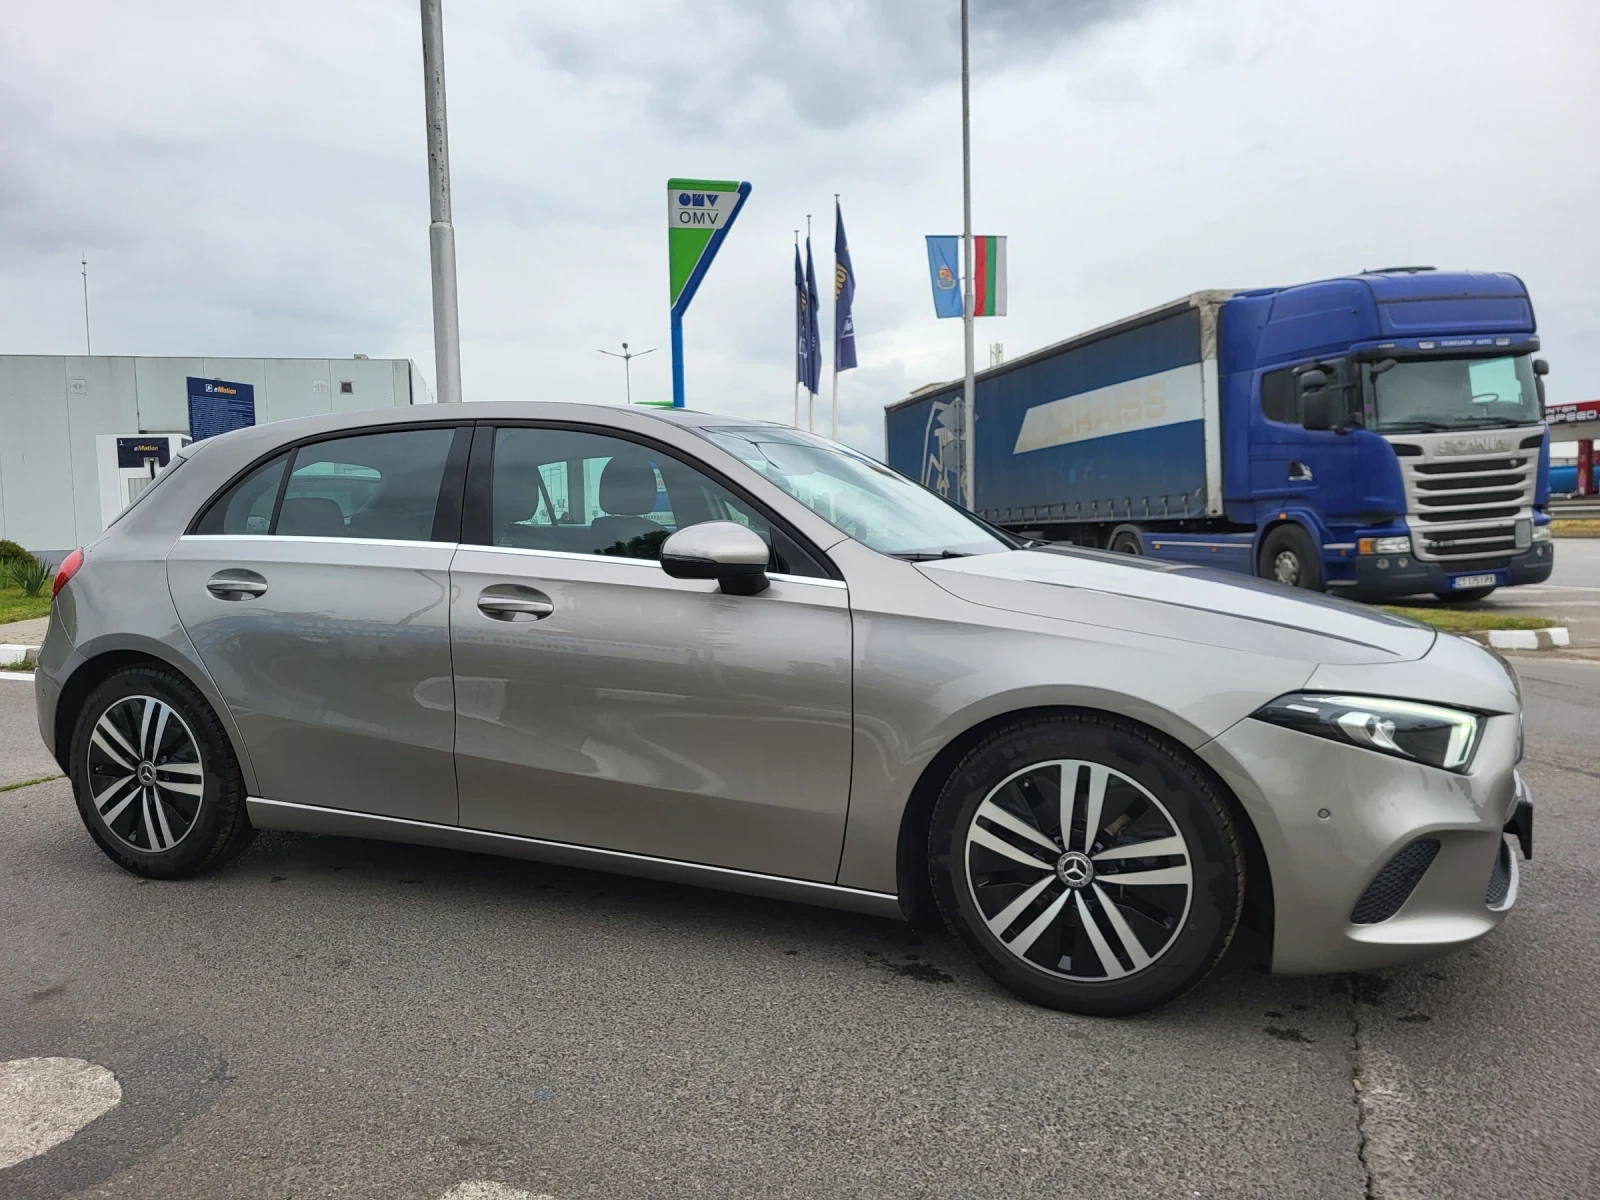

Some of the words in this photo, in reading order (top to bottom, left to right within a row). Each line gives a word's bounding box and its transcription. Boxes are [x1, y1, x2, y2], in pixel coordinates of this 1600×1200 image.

[679, 211, 719, 225] OMV
[213, 385, 237, 395] eMotion
[133, 444, 159, 452] eMotion
[1437, 437, 1506, 453] SCANIA
